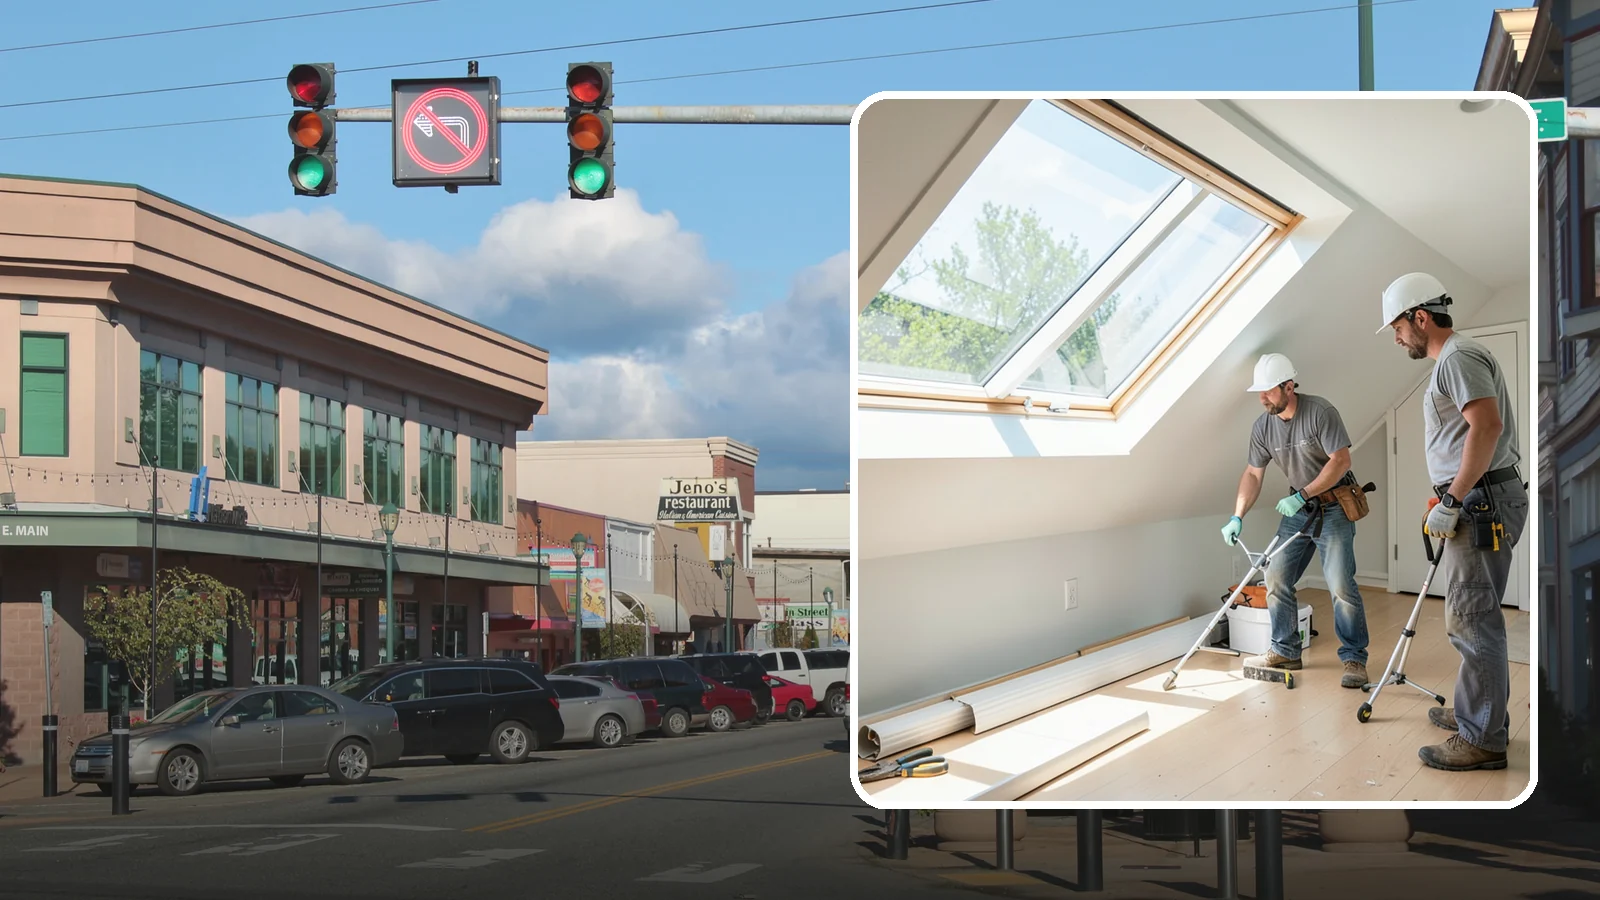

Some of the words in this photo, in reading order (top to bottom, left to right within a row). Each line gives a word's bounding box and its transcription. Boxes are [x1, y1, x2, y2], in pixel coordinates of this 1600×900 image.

[669, 480, 728, 495] Jeno's
[665, 496, 731, 509] restaurant
[658, 509, 681, 519] Italian
[686, 509, 715, 520] American
[715, 509, 738, 519] Cuisine
[2, 525, 13, 536] E.
[15, 525, 49, 536] MAIN
[797, 607, 829, 617] Street
